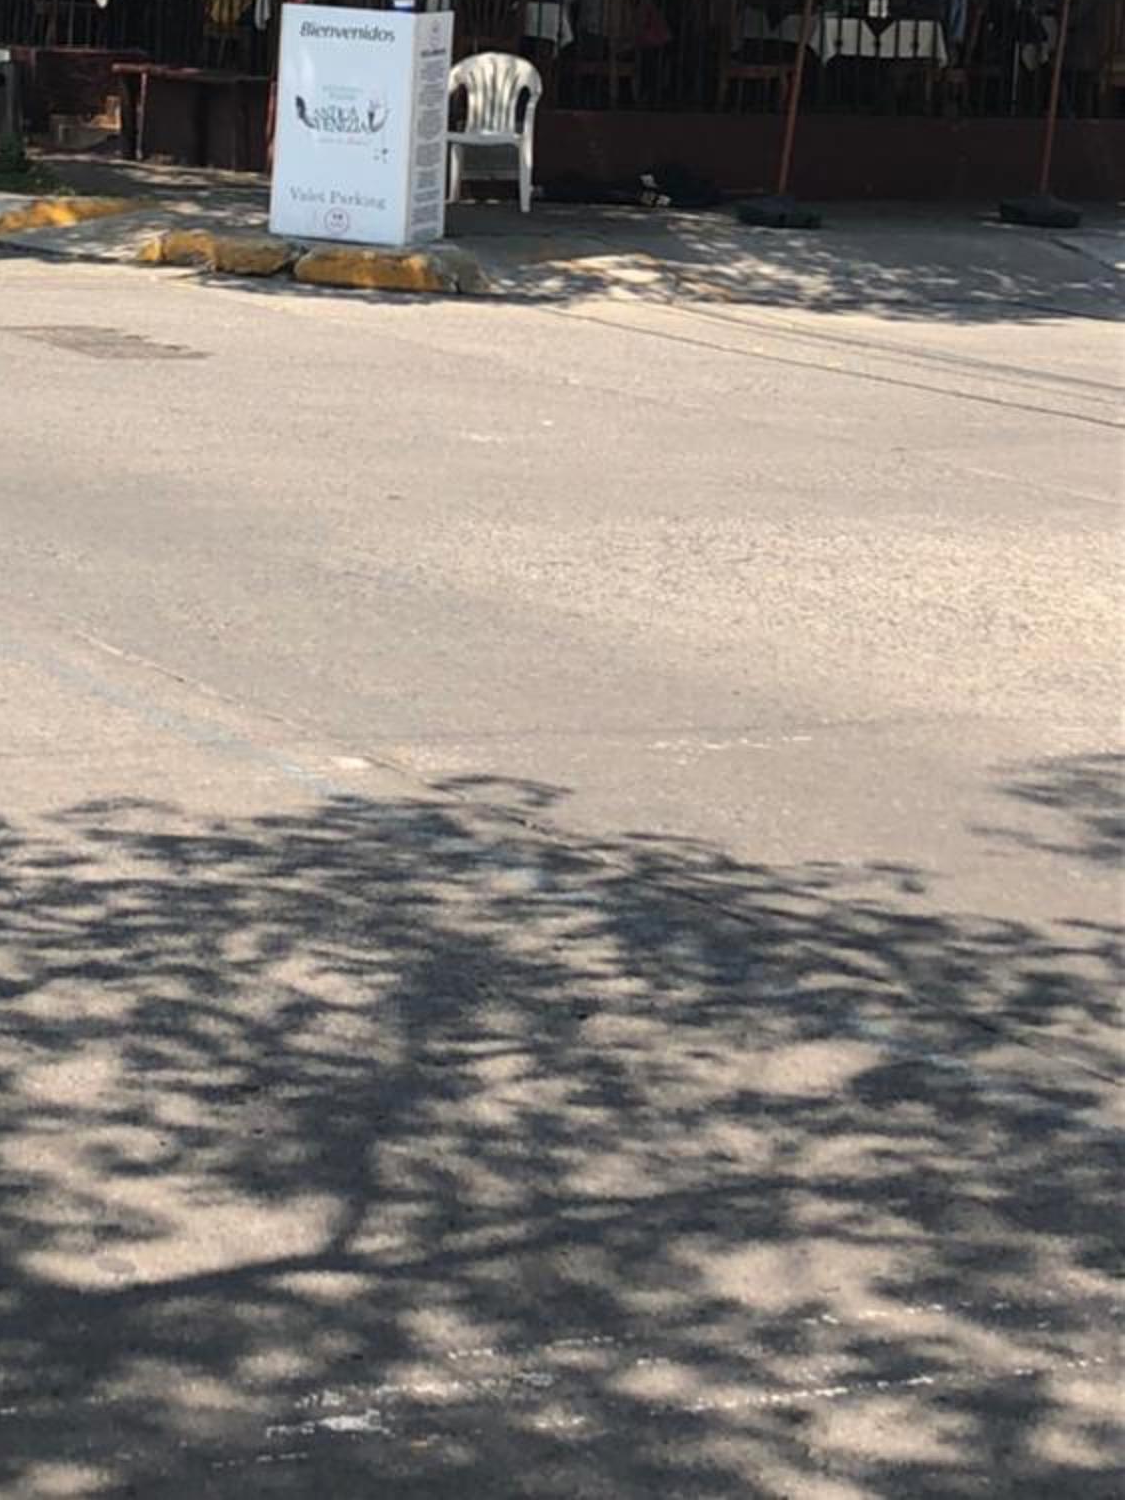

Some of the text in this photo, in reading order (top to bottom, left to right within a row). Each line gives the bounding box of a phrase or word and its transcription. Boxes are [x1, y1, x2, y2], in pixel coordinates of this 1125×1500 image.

[299, 21, 395, 42] Bienvenidos
[289, 186, 387, 213] Valet Parking
